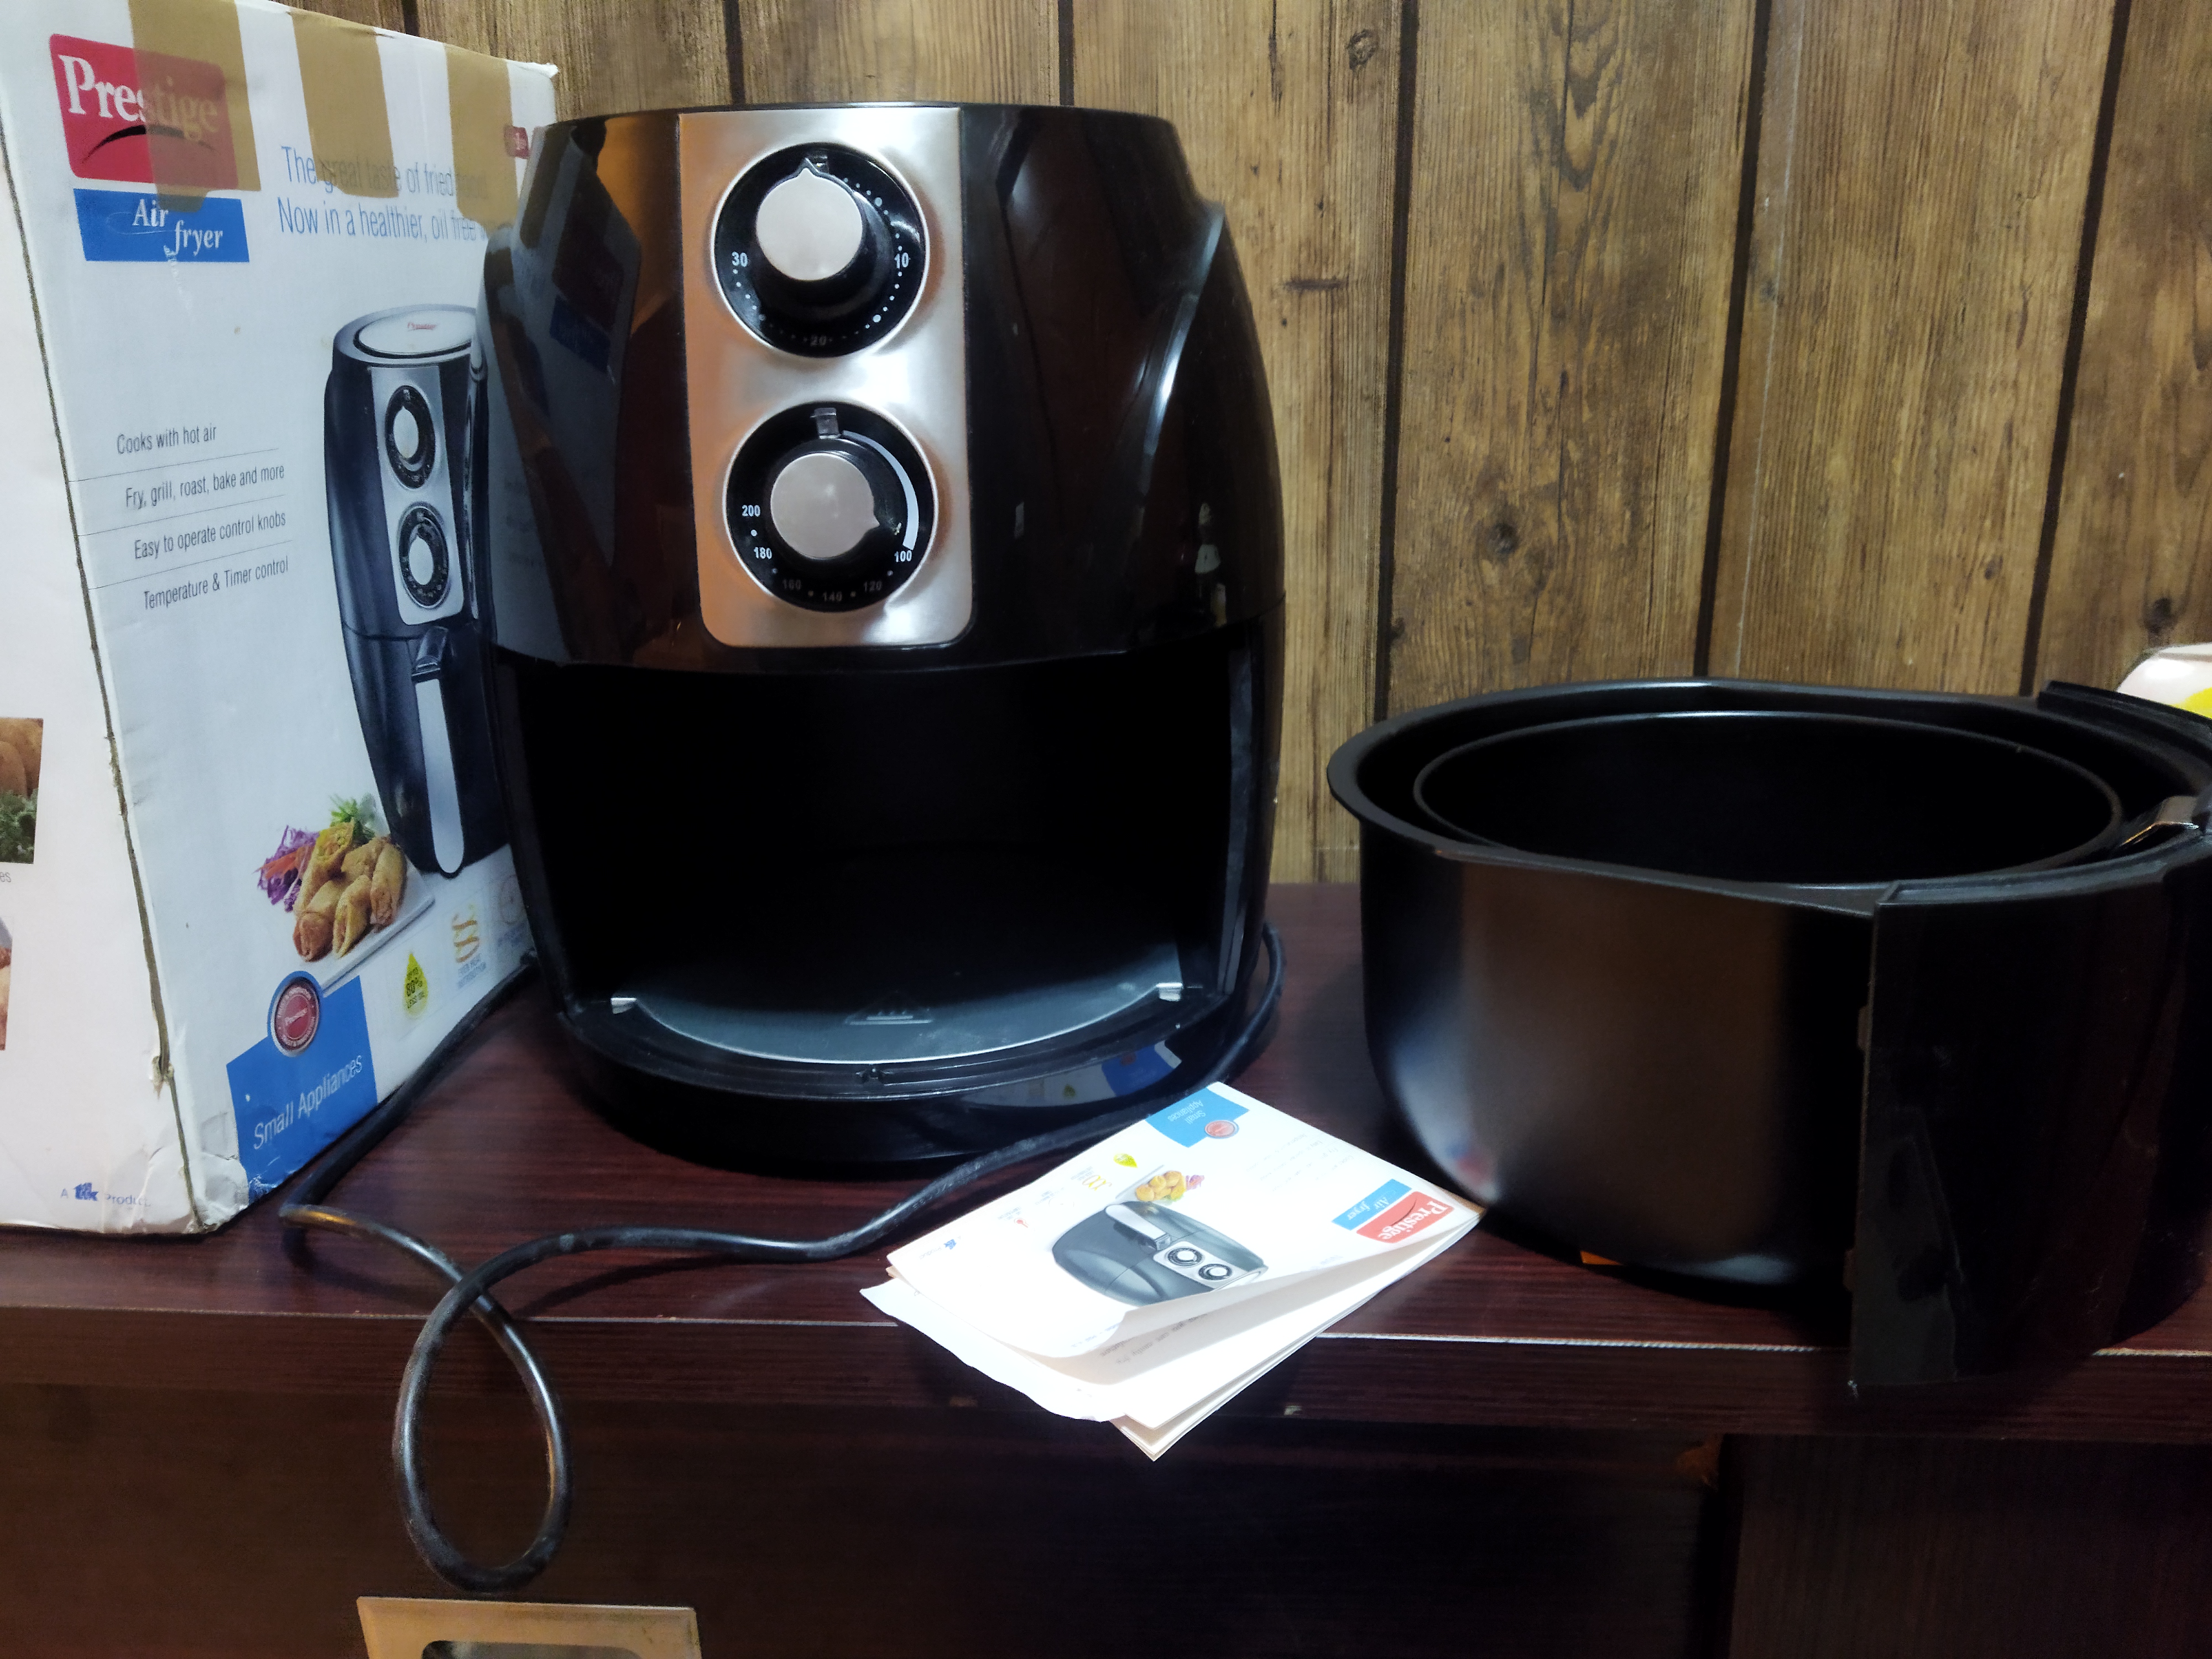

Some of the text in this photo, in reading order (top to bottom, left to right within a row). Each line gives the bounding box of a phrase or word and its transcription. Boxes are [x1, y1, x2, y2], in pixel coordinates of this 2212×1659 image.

[58, 54, 218, 142] Prestige
[281, 145, 316, 185] The
[406, 161, 421, 194] of
[424, 164, 454, 197] fried
[132, 199, 223, 256] Air fryer
[278, 196, 319, 235] Now
[324, 201, 341, 235] in
[345, 210, 356, 236] a
[358, 202, 427, 243] healthier,
[431, 214, 448, 240] oil
[451, 215, 477, 242] free
[732, 252, 909, 269] 30 10
[810, 334, 827, 347] 20
[117, 423, 217, 455] Cooks with hot air
[126, 465, 285, 510] Fry, grill, roast, bake and more
[742, 504, 761, 517] 200
[134, 510, 286, 560] Easy to operate control knobs
[753, 546, 773, 560] 180
[894, 550, 912, 562] 100
[144, 554, 289, 610] Temperature & Timer control
[782, 579, 801, 590] 160
[863, 580, 882, 591] 120
[822, 591, 842, 602] 140
[253, 1054, 363, 1150] Small Appliances
[1167, 1099, 1203, 1122] Appliances
[1184, 1110, 1206, 1125] Small
[60, 1188, 69, 1199] A
[1345, 1196, 1390, 1221] Air fryer
[1382, 1199, 1450, 1241] Prestige
